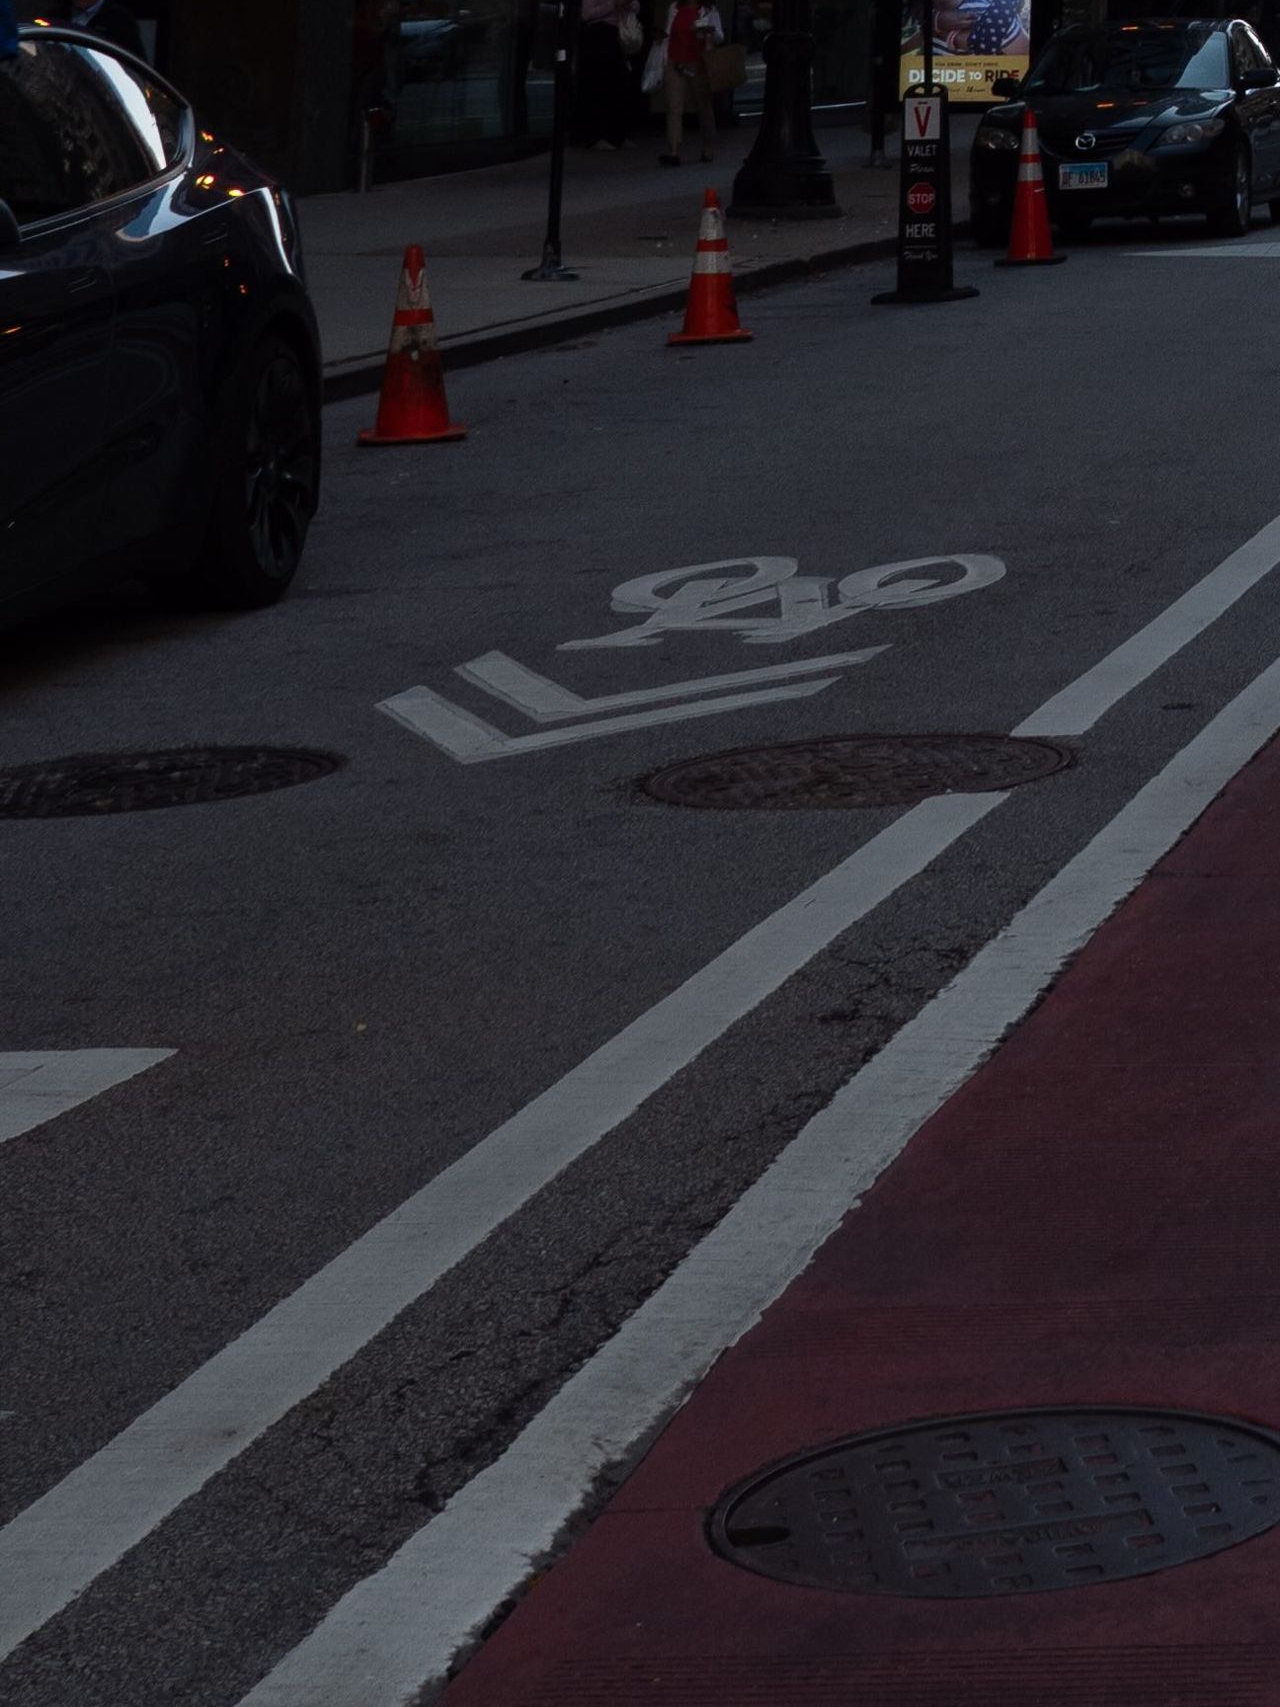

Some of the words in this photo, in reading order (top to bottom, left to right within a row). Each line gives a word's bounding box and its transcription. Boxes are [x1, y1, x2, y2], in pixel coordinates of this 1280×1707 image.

[969, 71, 982, 82] TO
[914, 106, 932, 138] V
[906, 144, 937, 157] VALET
[906, 192, 936, 206] STOP
[905, 222, 937, 239] HERE
